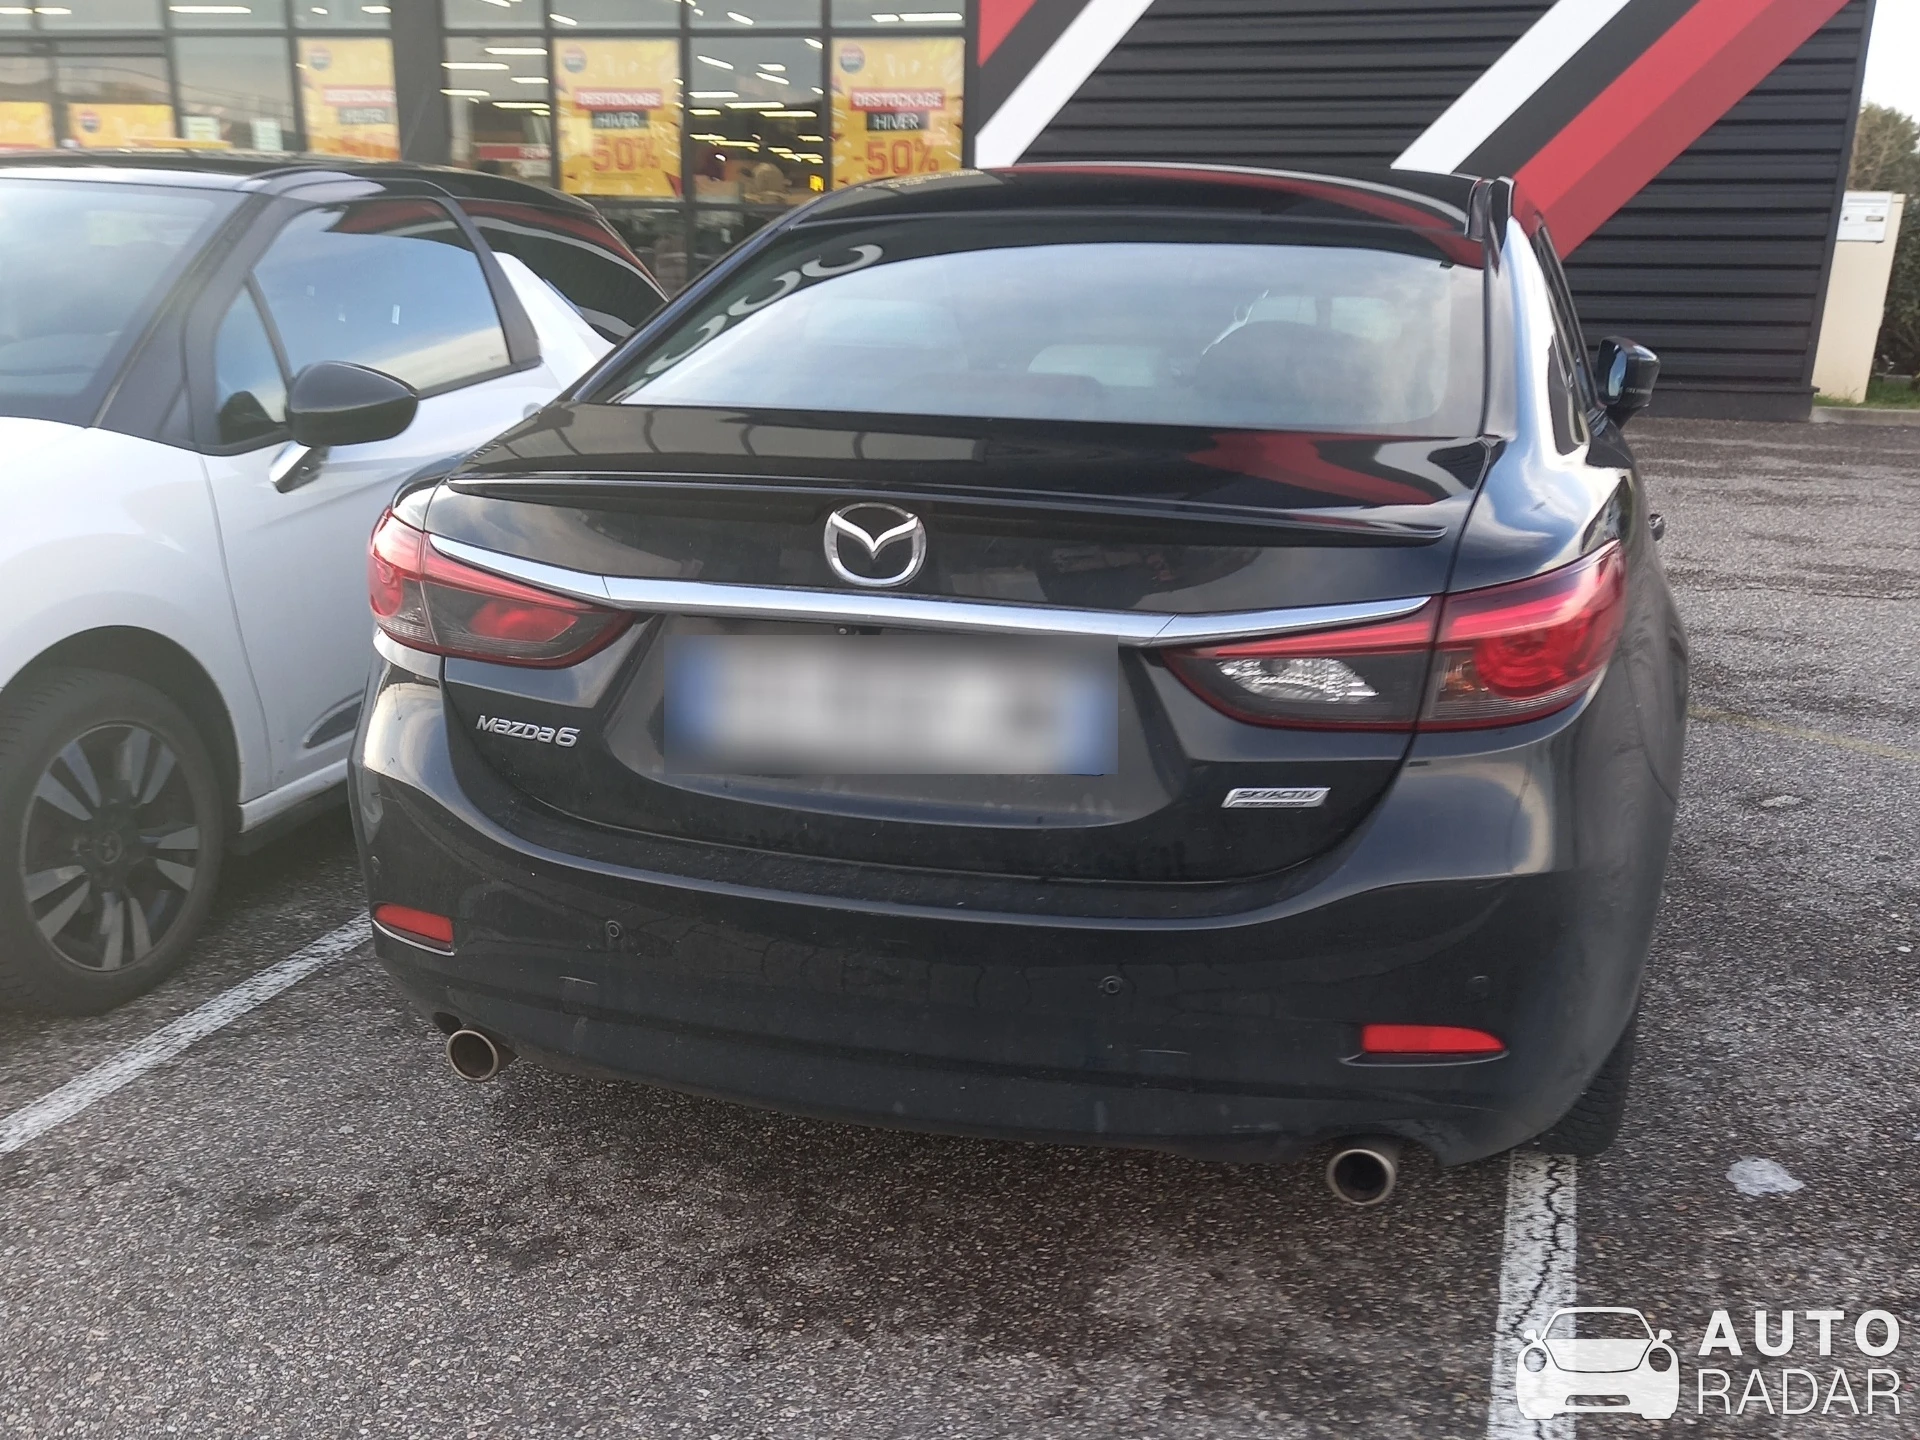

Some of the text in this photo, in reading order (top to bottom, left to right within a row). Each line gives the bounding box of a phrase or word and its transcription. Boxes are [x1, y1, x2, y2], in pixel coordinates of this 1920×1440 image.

[579, 92, 660, 106] DESTOCKAGE
[852, 92, 942, 107] DESTOCKAGE
[597, 112, 640, 127] HIVER
[875, 112, 918, 130] HIVER
[853, 138, 940, 175] -50%
